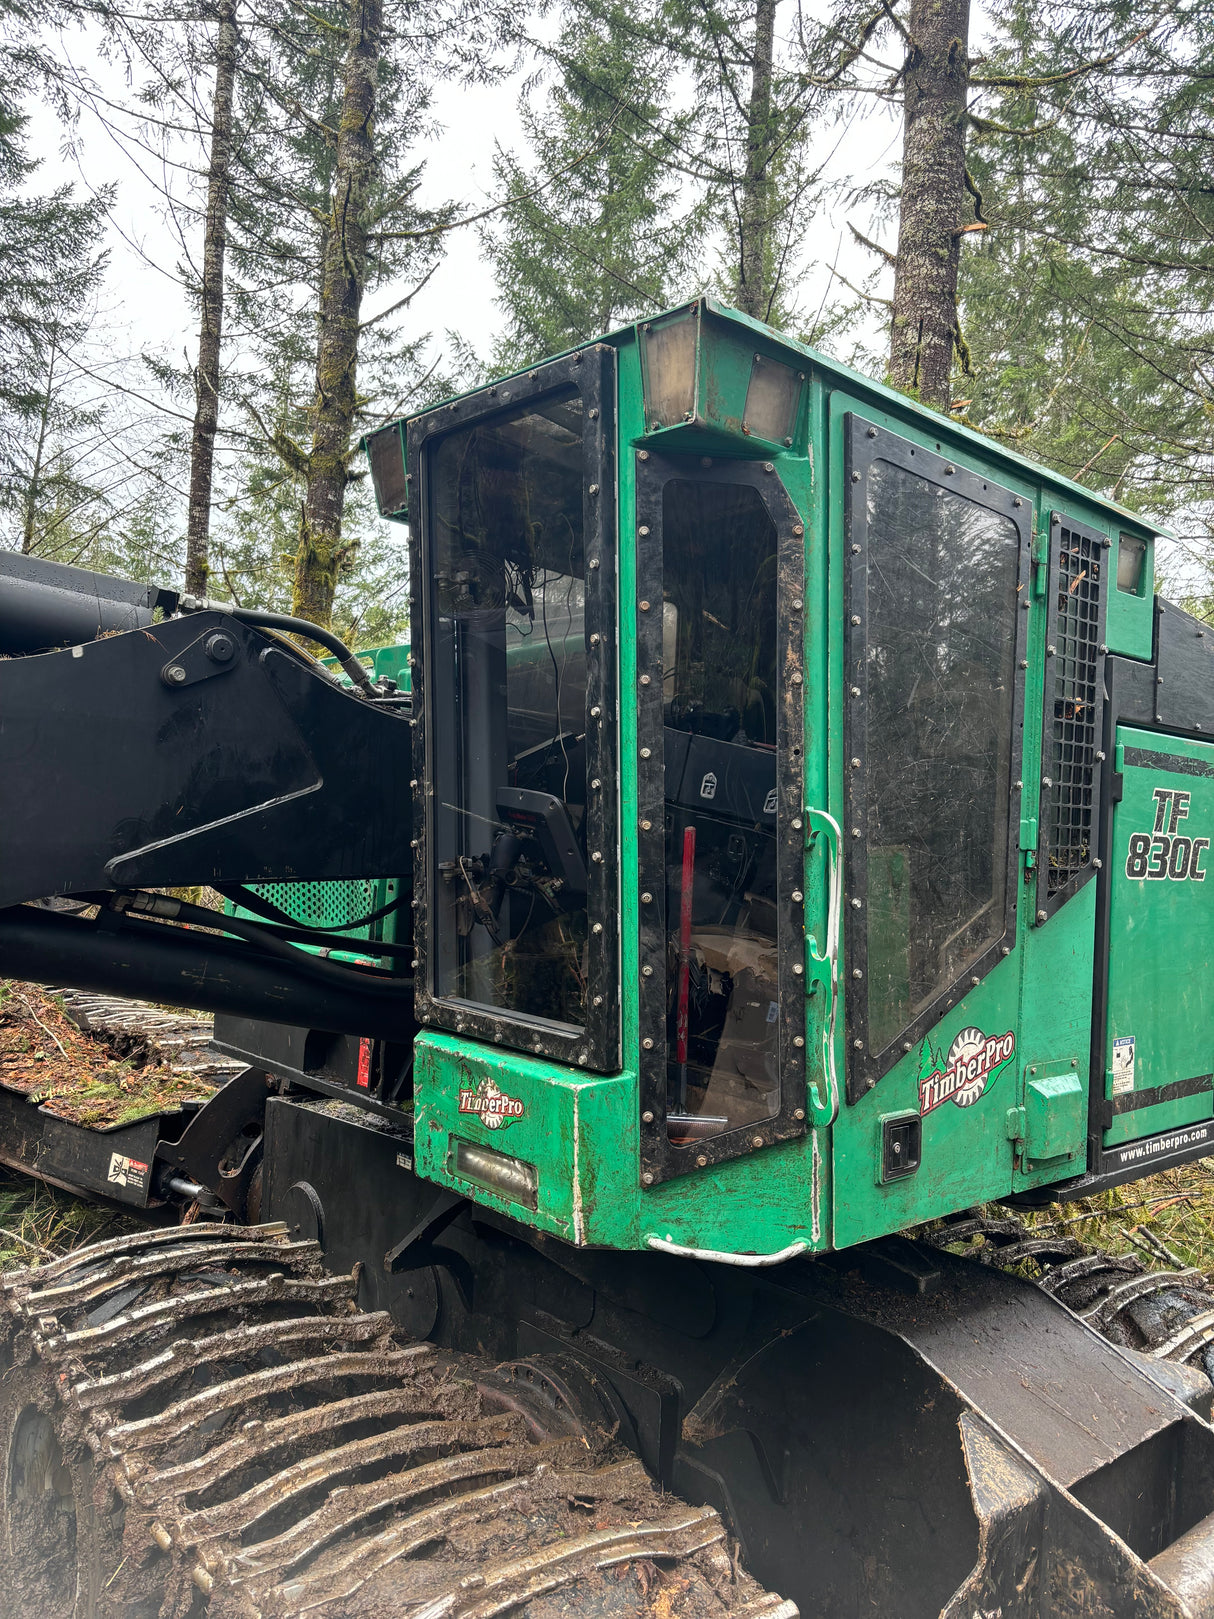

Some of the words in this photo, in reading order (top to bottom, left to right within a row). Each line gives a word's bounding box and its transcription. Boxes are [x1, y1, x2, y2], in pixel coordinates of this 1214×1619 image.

[1152, 787, 1191, 836] TF
[1125, 832, 1210, 882] 830C
[921, 1034, 1013, 1112] TimberPro
[1120, 1128, 1207, 1162] www.timberpro.com
